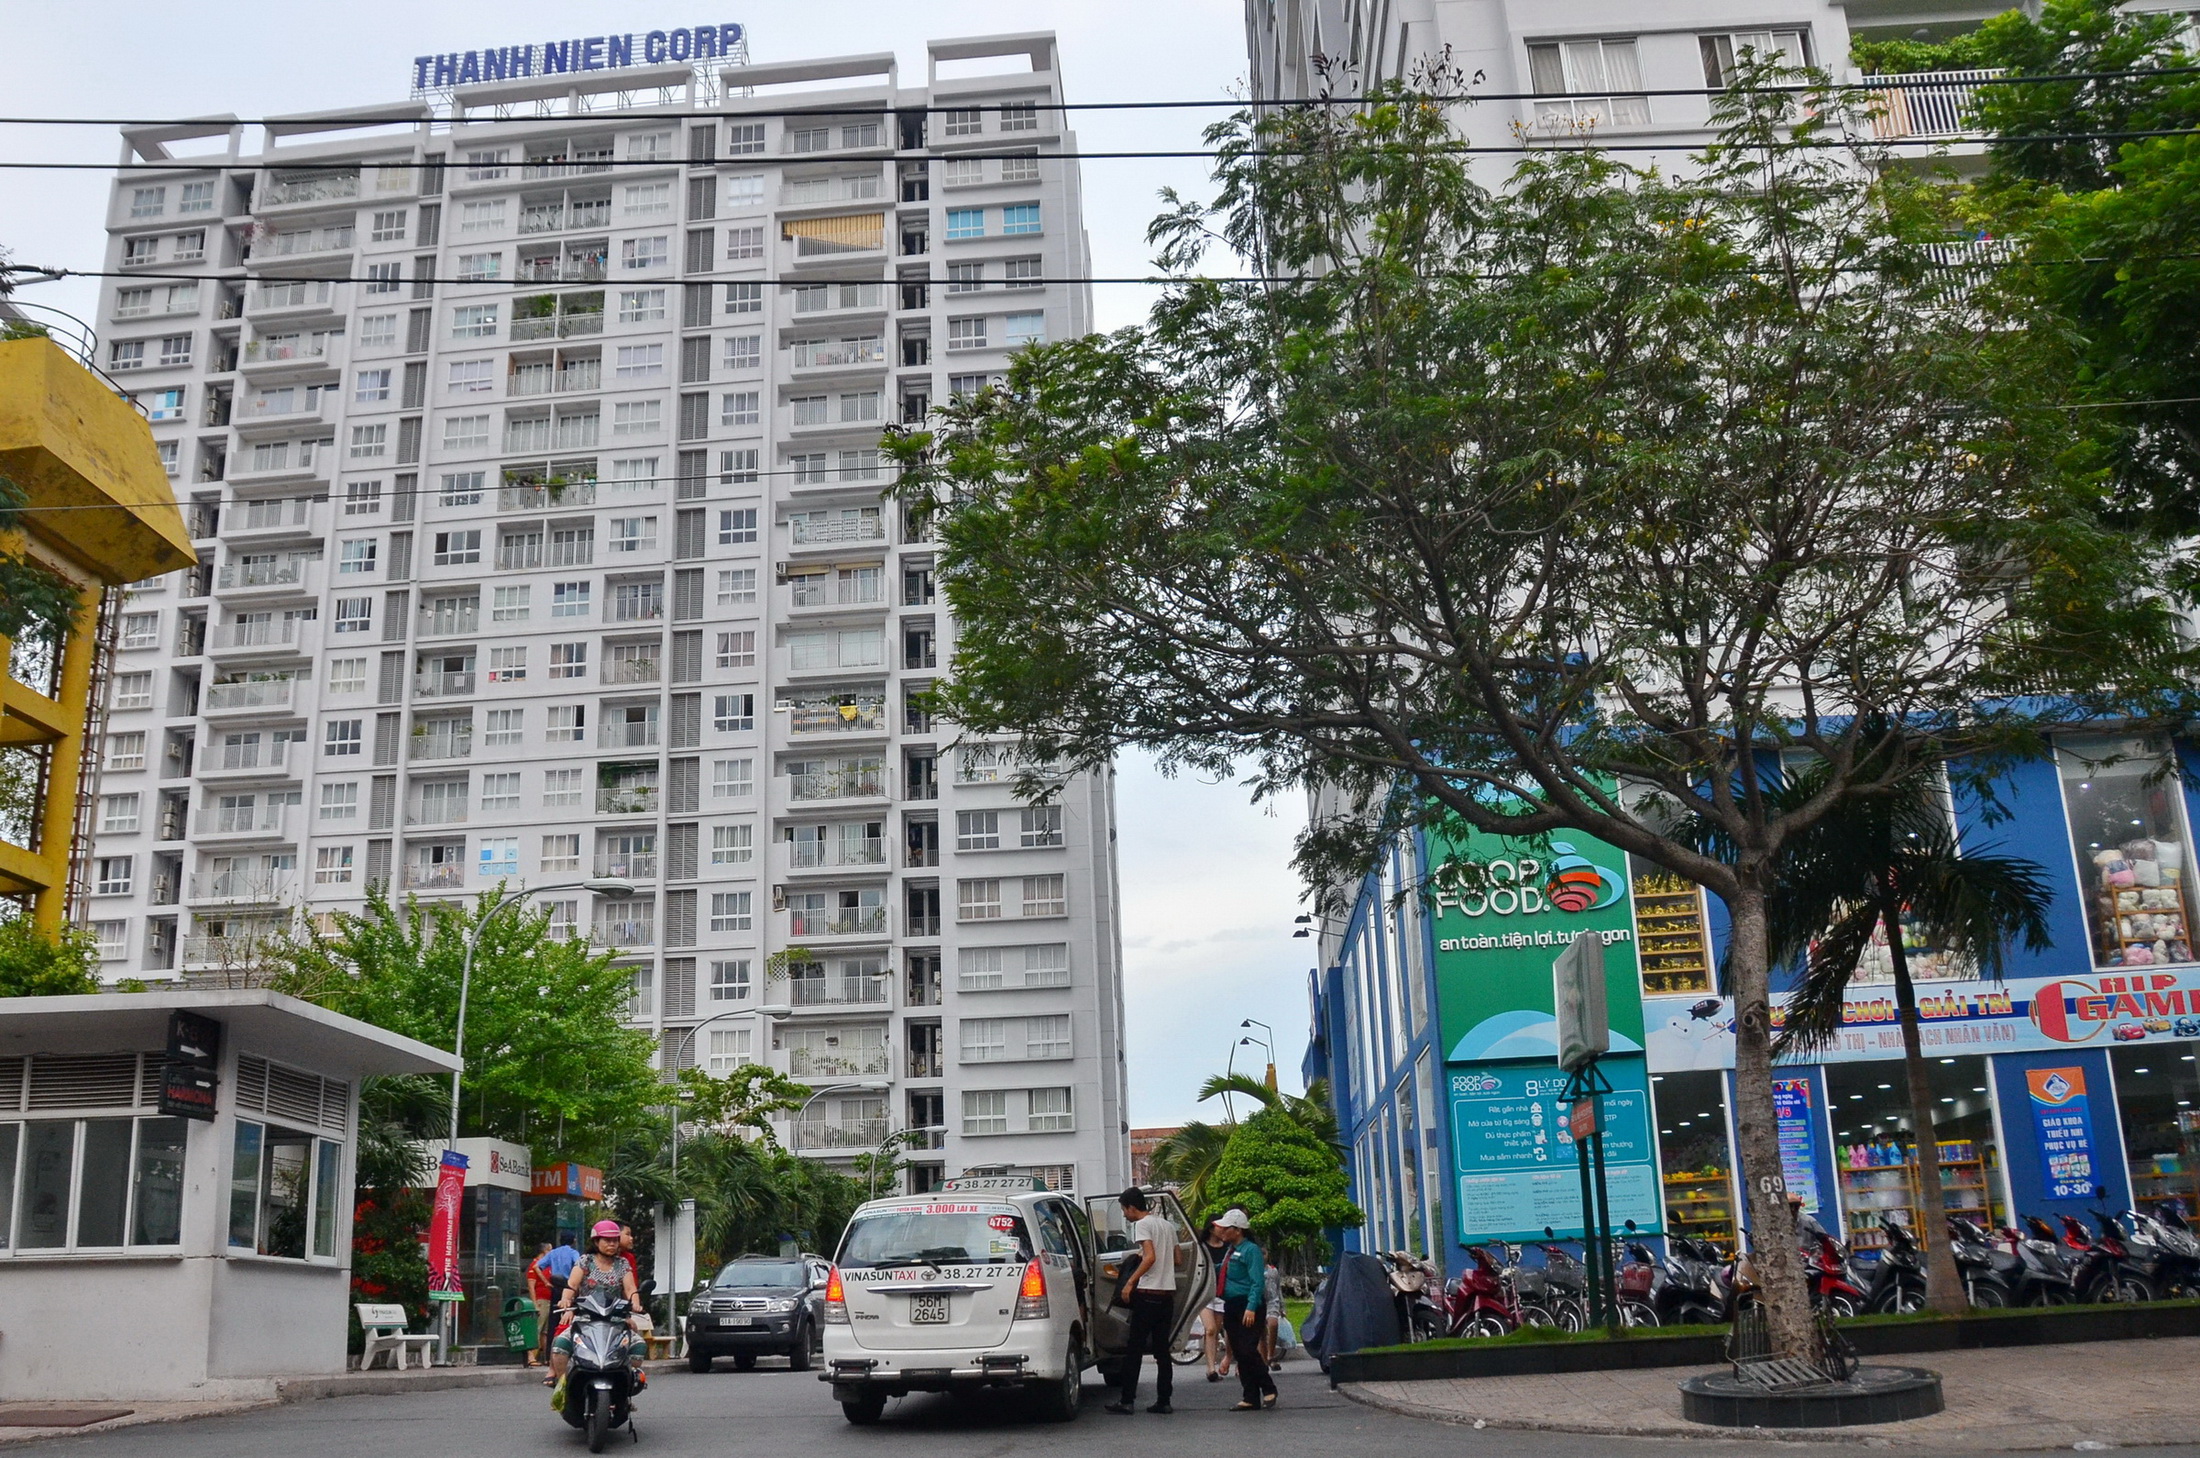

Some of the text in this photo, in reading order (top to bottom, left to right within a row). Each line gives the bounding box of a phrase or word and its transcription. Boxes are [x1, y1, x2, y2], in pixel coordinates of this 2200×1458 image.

[414, 22, 743, 89] THANH NIEN CORP
[1434, 859, 1541, 891] COOP
[1842, 996, 1895, 1024] CHƠI
[1919, 989, 1969, 1018] GIẢI
[1973, 988, 2013, 1016] TRÍ
[1945, 1024, 1981, 1044] NHÂN
[1452, 1075, 1481, 1084] COOP
[1452, 1083, 1481, 1092] FOOD
[1525, 1080, 1539, 1097] 8
[1552, 1078, 1567, 1088] DO
[2062, 1116, 2084, 1126] KHOA
[498, 1155, 530, 1178] SeABank
[584, 1175, 600, 1194] ATM
[964, 1178, 1032, 1189] 38.27 27 27
[1760, 1175, 1783, 1194] 69
[1770, 1192, 1780, 1205] A
[926, 1204, 956, 1214] 3.000
[969, 1205, 979, 1213] XE
[989, 1217, 1014, 1227] 4752
[943, 1267, 983, 1280] 38.27
[986, 1266, 1003, 1278] 27
[1006, 1266, 1023, 1278] 27
[918, 1296, 943, 1308] 56M
[914, 1308, 946, 1321] 2645
